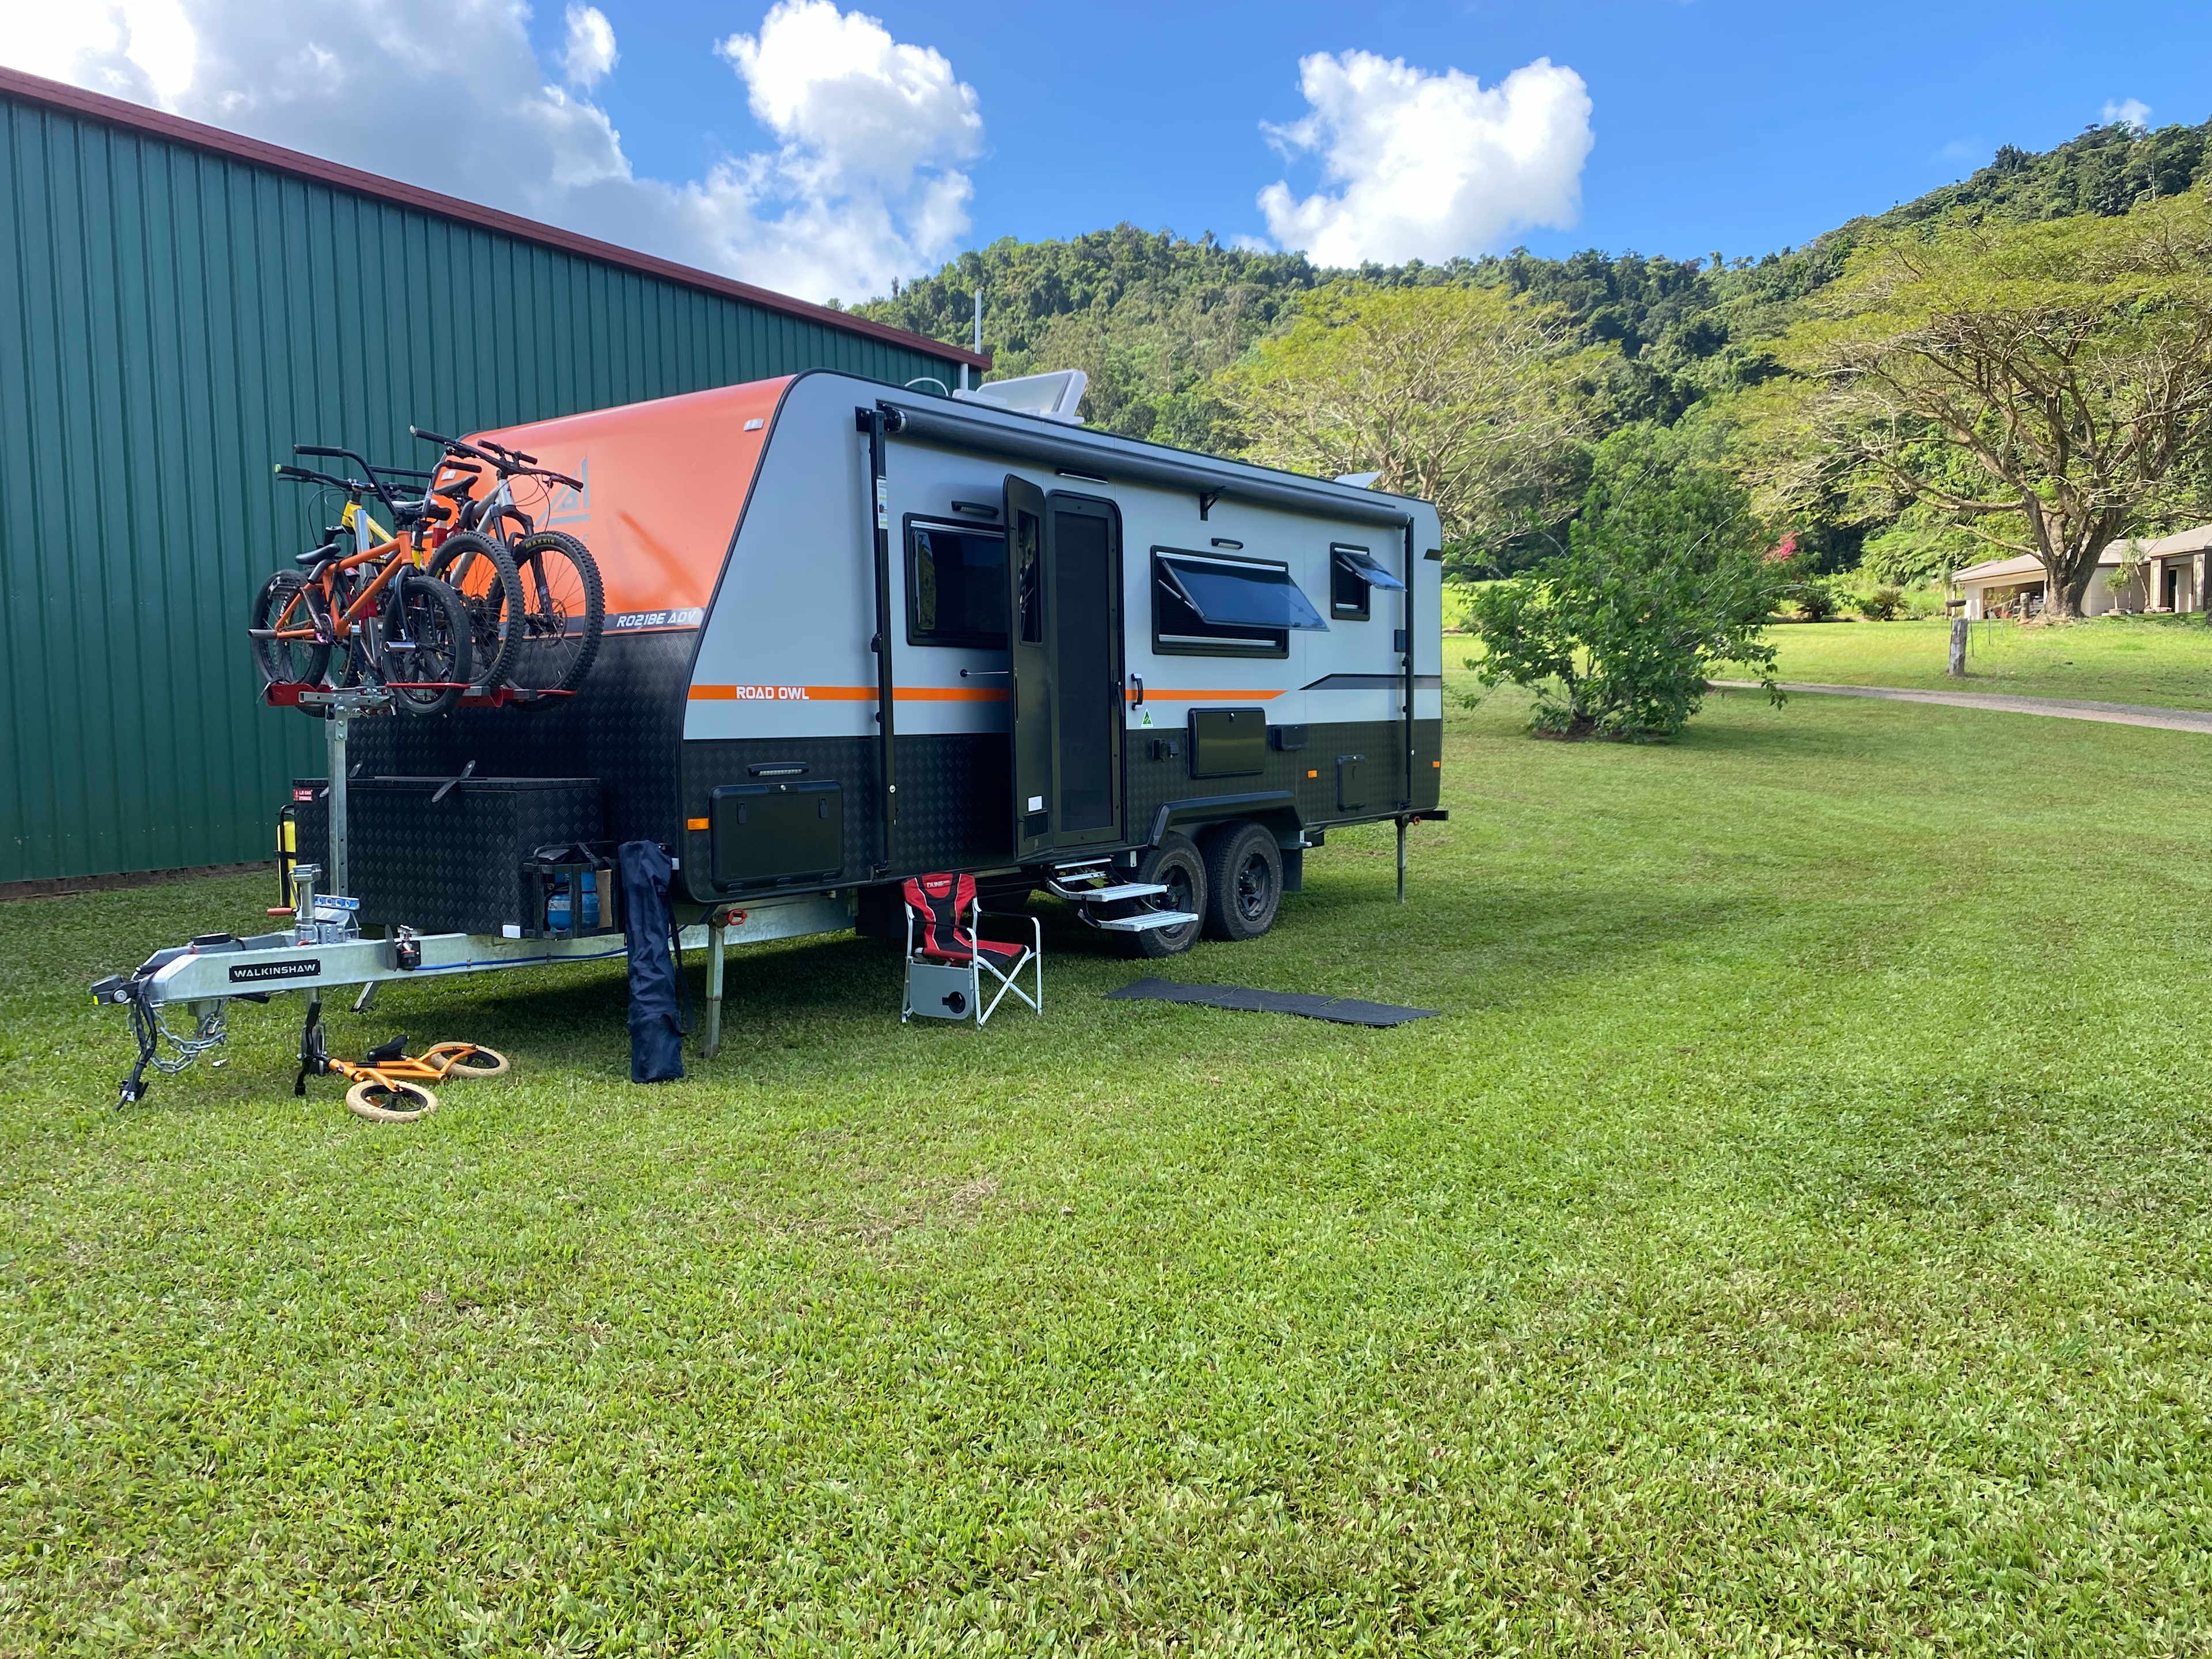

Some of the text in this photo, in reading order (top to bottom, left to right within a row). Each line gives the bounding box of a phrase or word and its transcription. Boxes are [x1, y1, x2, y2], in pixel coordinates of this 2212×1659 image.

[667, 610, 696, 624] ADV
[736, 686, 809, 700] ROAD OWL
[234, 964, 316, 978] WALKINSHAW
